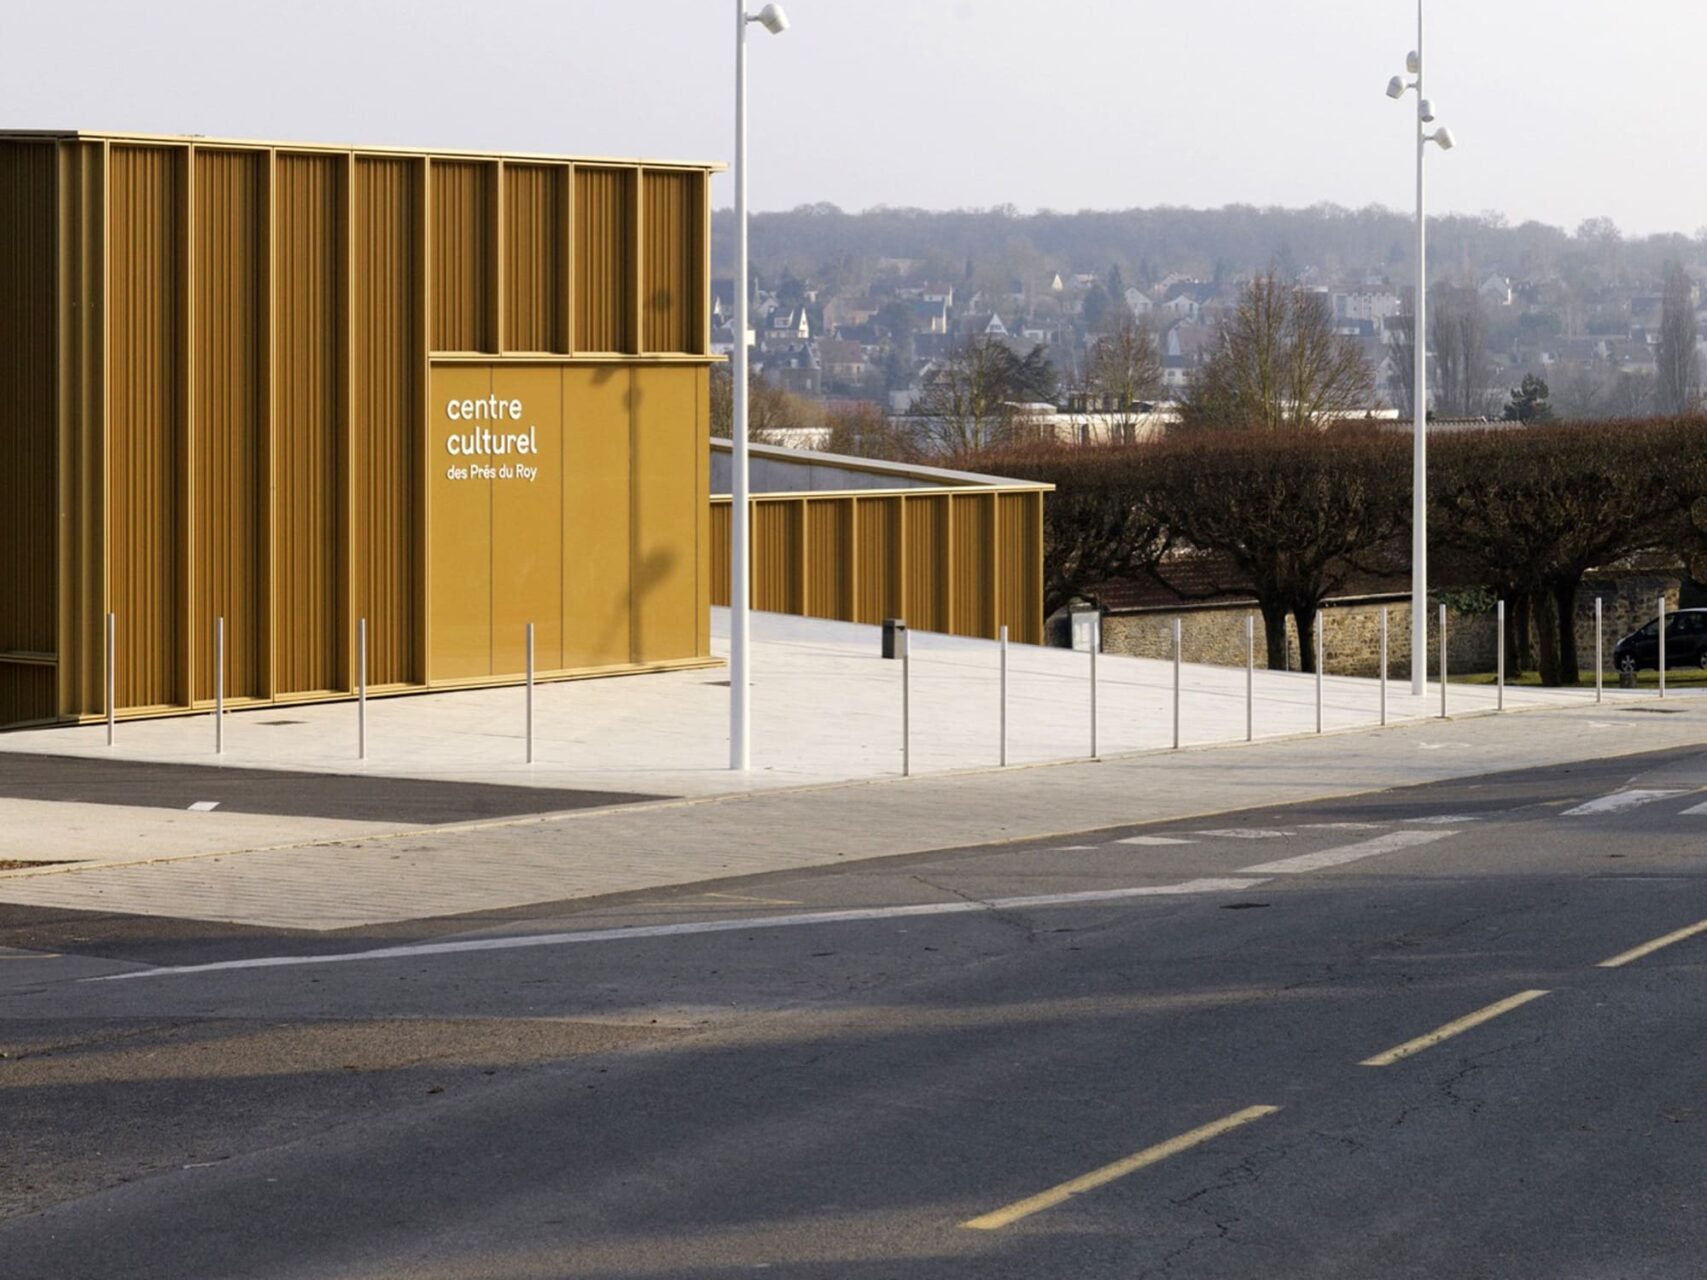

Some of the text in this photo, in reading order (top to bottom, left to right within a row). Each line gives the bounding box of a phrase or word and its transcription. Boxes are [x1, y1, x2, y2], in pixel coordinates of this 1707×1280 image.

[447, 393, 522, 420] centre
[447, 426, 537, 455] culturel
[447, 463, 537, 482] des Prés du Roy
